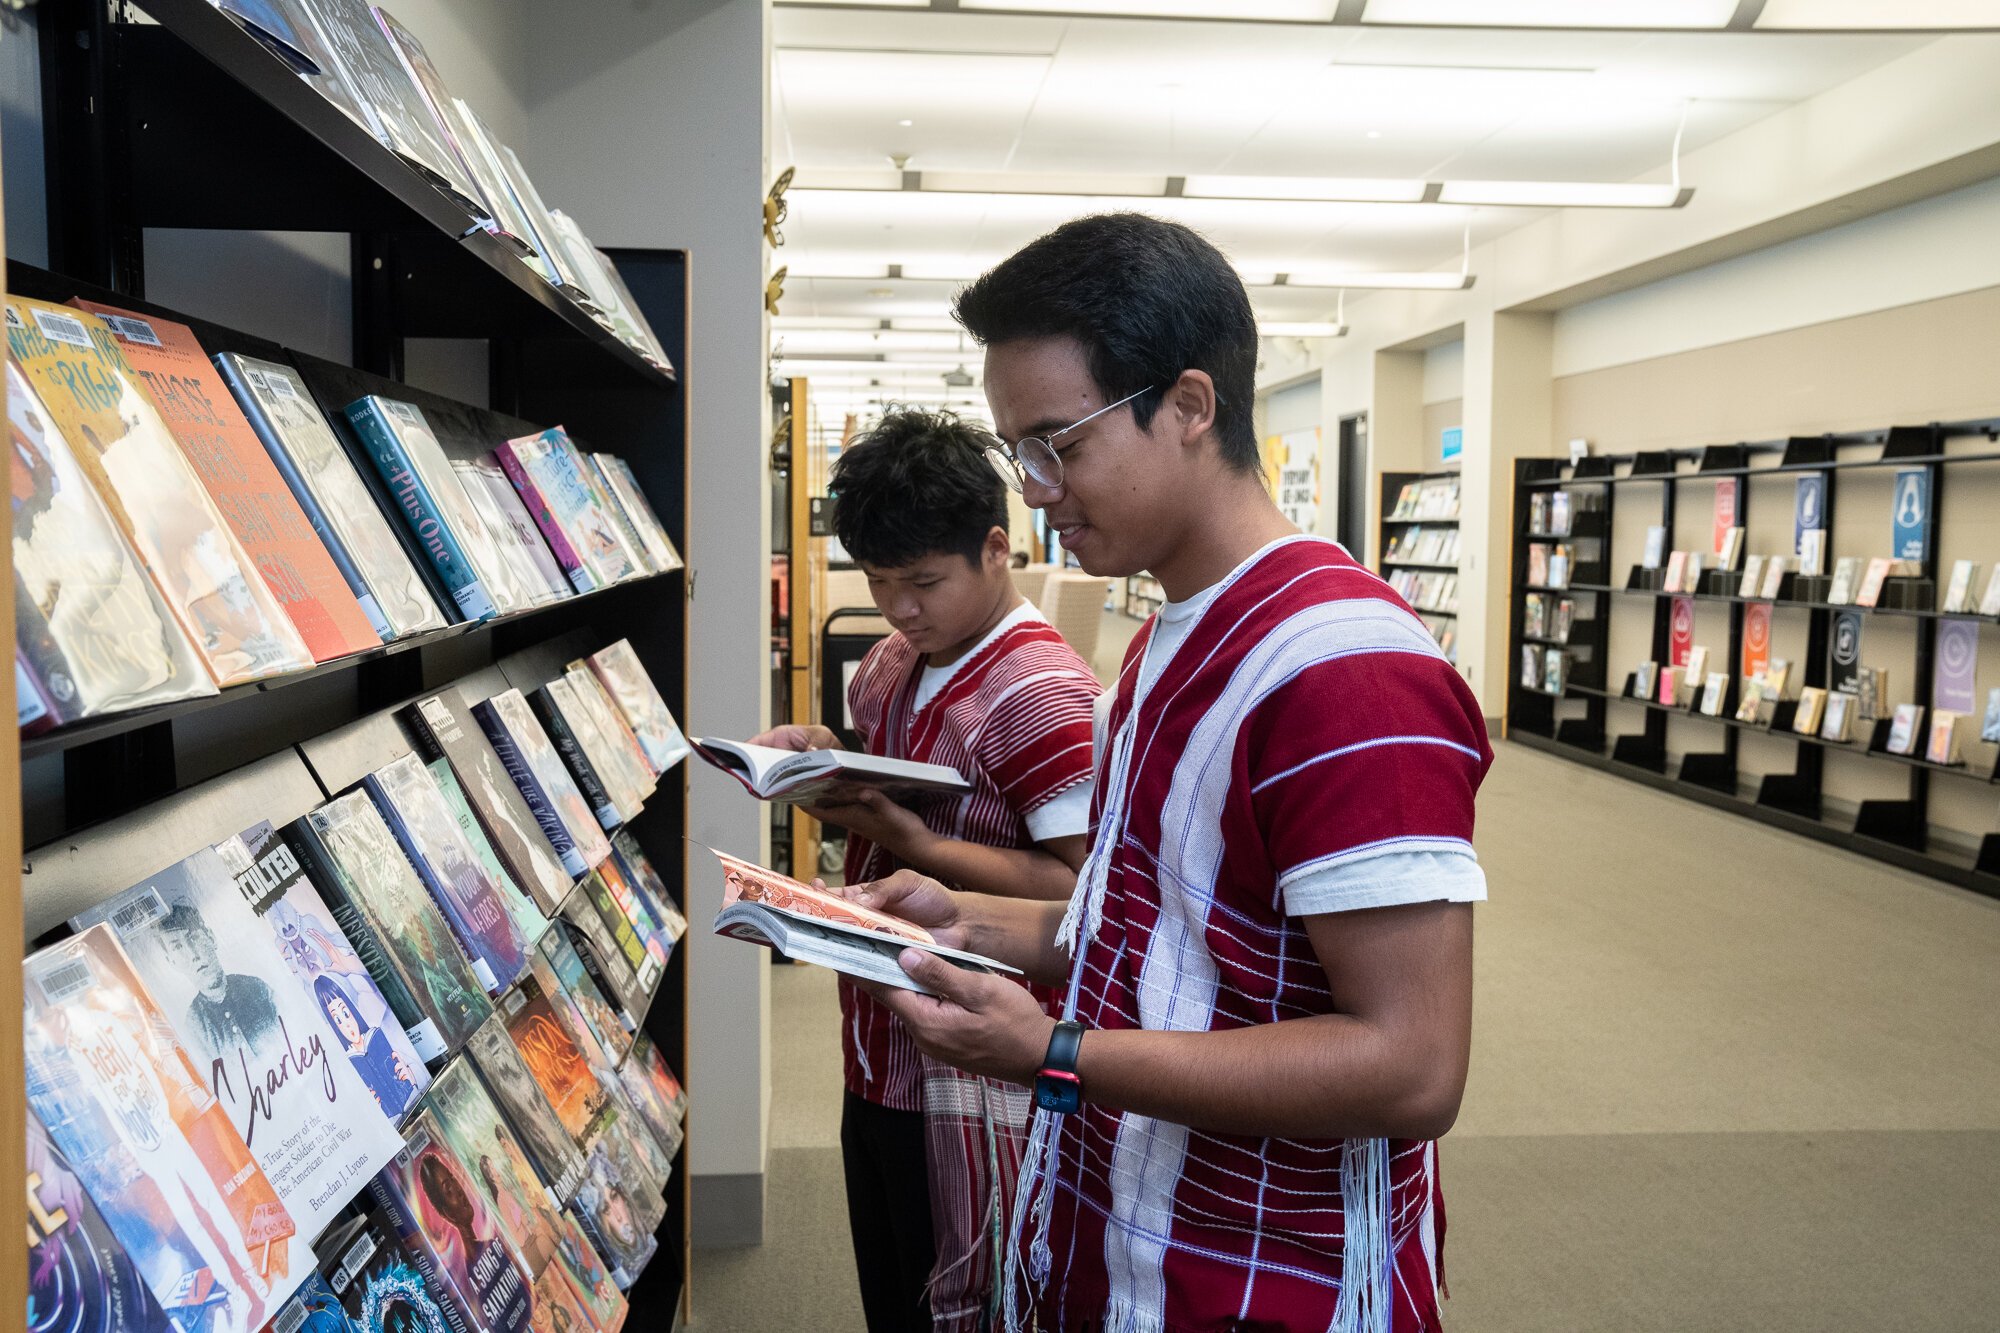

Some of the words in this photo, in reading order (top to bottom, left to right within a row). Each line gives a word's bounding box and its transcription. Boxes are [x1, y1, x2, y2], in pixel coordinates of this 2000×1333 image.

[56, 361, 123, 414] RIGH
[138, 369, 226, 427] THOSE
[418, 518, 451, 564] One
[494, 738, 532, 784] LITTLE
[520, 782, 538, 804] LIKE
[532, 804, 574, 854] WAKING
[472, 895, 501, 934] FIRES
[212, 1014, 337, 1150] Charley
[264, 1142, 285, 1167] True
[282, 1129, 303, 1154] Story
[301, 1122, 312, 1138] of
[309, 1114, 322, 1130] the
[270, 1160, 294, 1186] ungest
[293, 1141, 317, 1165] Soldier
[323, 1121, 337, 1139] Die
[279, 1184, 292, 1201] the
[292, 1159, 324, 1189] American
[322, 1141, 341, 1162] Civil
[337, 1127, 353, 1145] War
[309, 1179, 343, 1212] Brendan
[349, 1152, 370, 1175] Lyons
[388, 1208, 404, 1227] DOW
[416, 1255, 435, 1284] SONG
[432, 1281, 442, 1292] OF
[473, 1247, 500, 1289] SONG
[492, 1236, 505, 1259] OF
[334, 1272, 347, 1287] YAS
[469, 1276, 480, 1295] A
[481, 1260, 522, 1327] SALVATION
